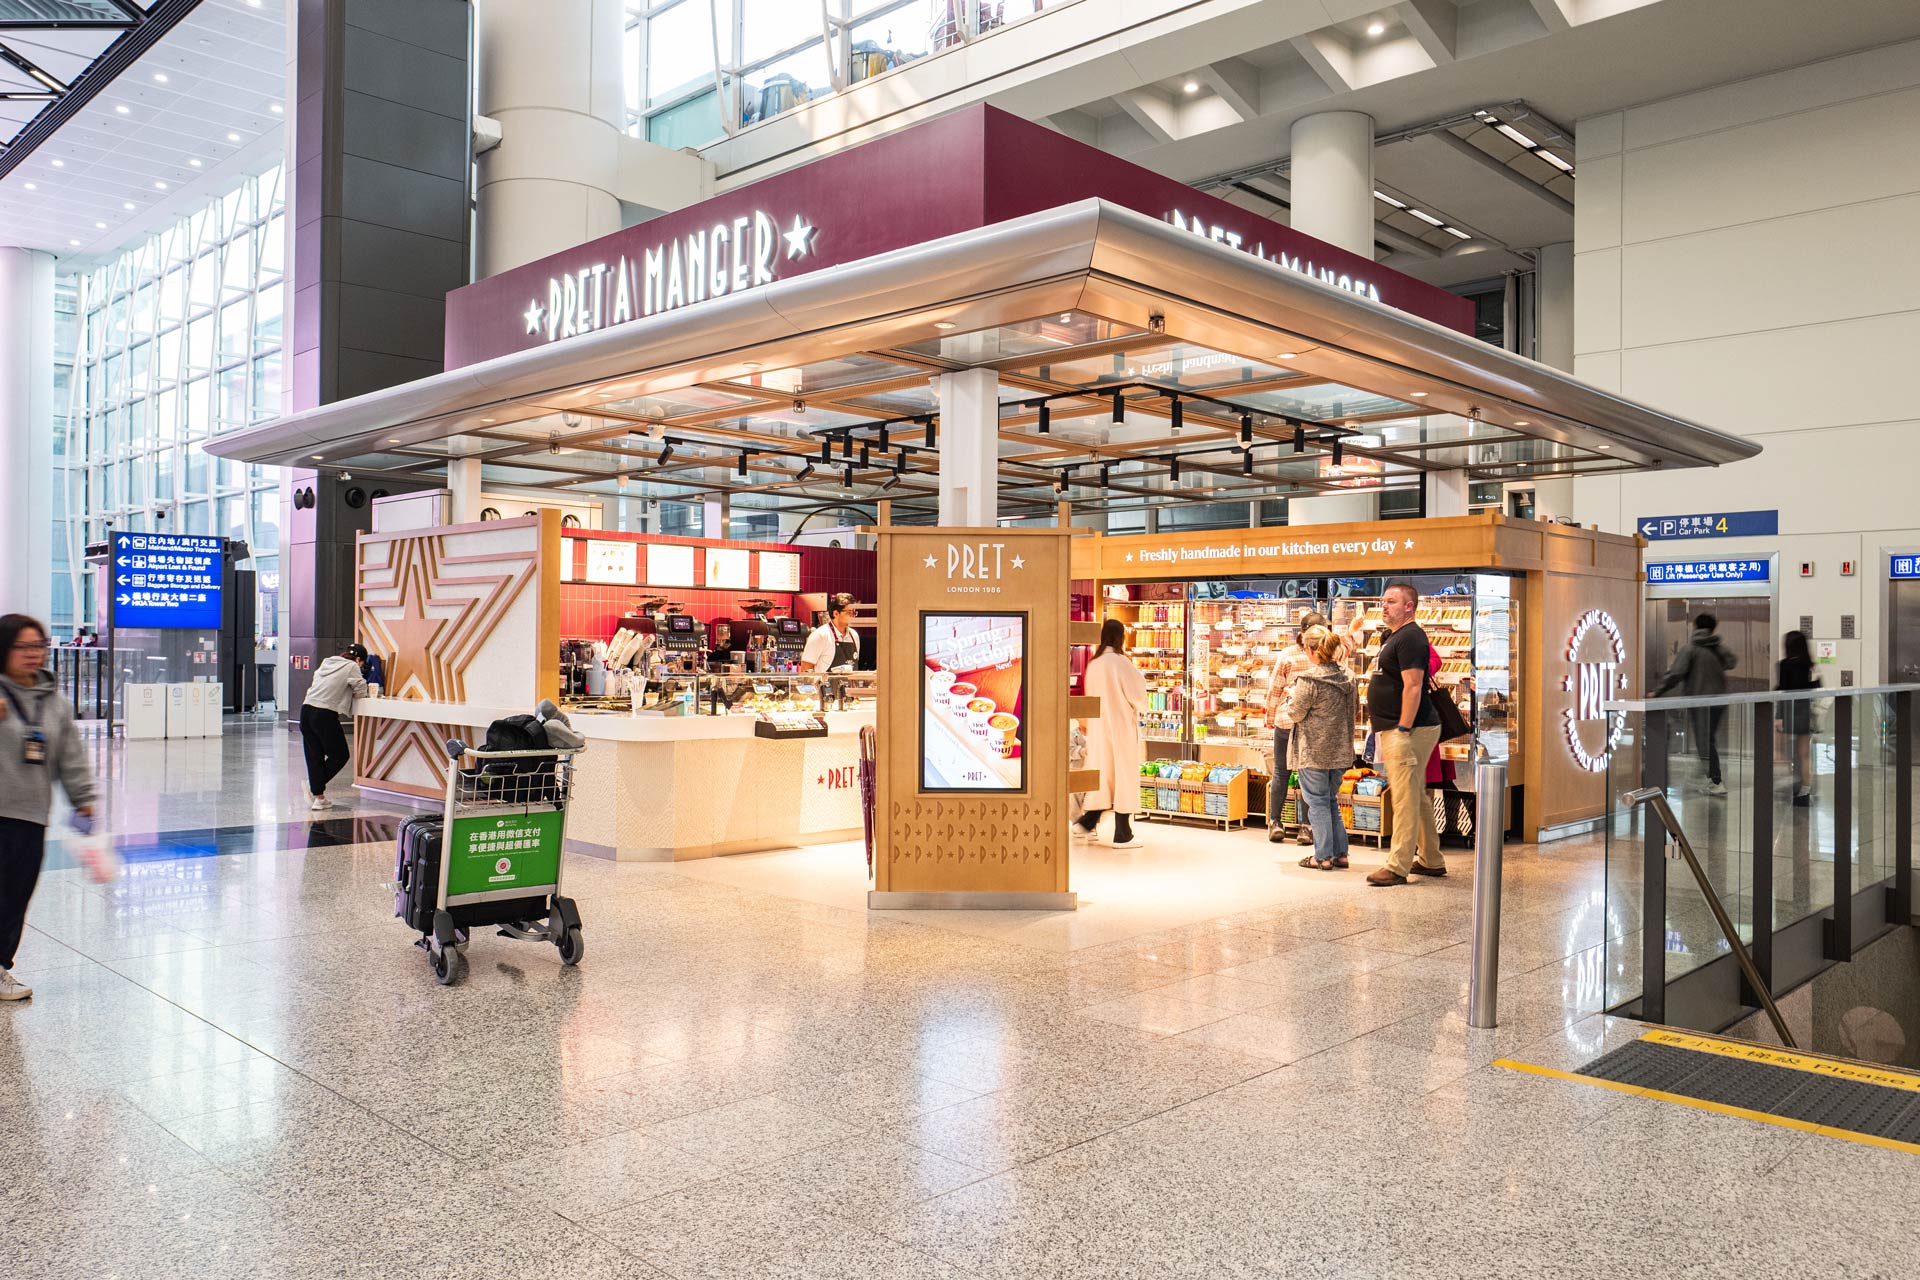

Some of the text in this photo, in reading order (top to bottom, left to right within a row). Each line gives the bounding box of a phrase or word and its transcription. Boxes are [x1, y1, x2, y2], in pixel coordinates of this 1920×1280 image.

[549, 210, 772, 342] PRET A MANGER
[1679, 516, 1729, 533] 停車場 4
[1693, 527, 1710, 535] Park
[195, 546, 221, 554] Transport
[947, 543, 1005, 579] PRET
[1139, 537, 1397, 563] Freshly handmade in our kitchen every day
[147, 563, 168, 571] Airport
[170, 582, 190, 590] Storage
[201, 583, 221, 591] Delivery
[946, 629, 1002, 652] Spring
[1568, 609, 1626, 664] ORGANIC COFFEE
[939, 644, 1014, 672] Selection
[995, 660, 1012, 671] New!
[1580, 662, 1616, 720] PRET
[828, 766, 855, 790] PRET
[967, 771, 982, 781] PRET
[469, 827, 541, 842] 在香港用微信支付
[1658, 1034, 1907, 1086] 請小心梯級 Please
